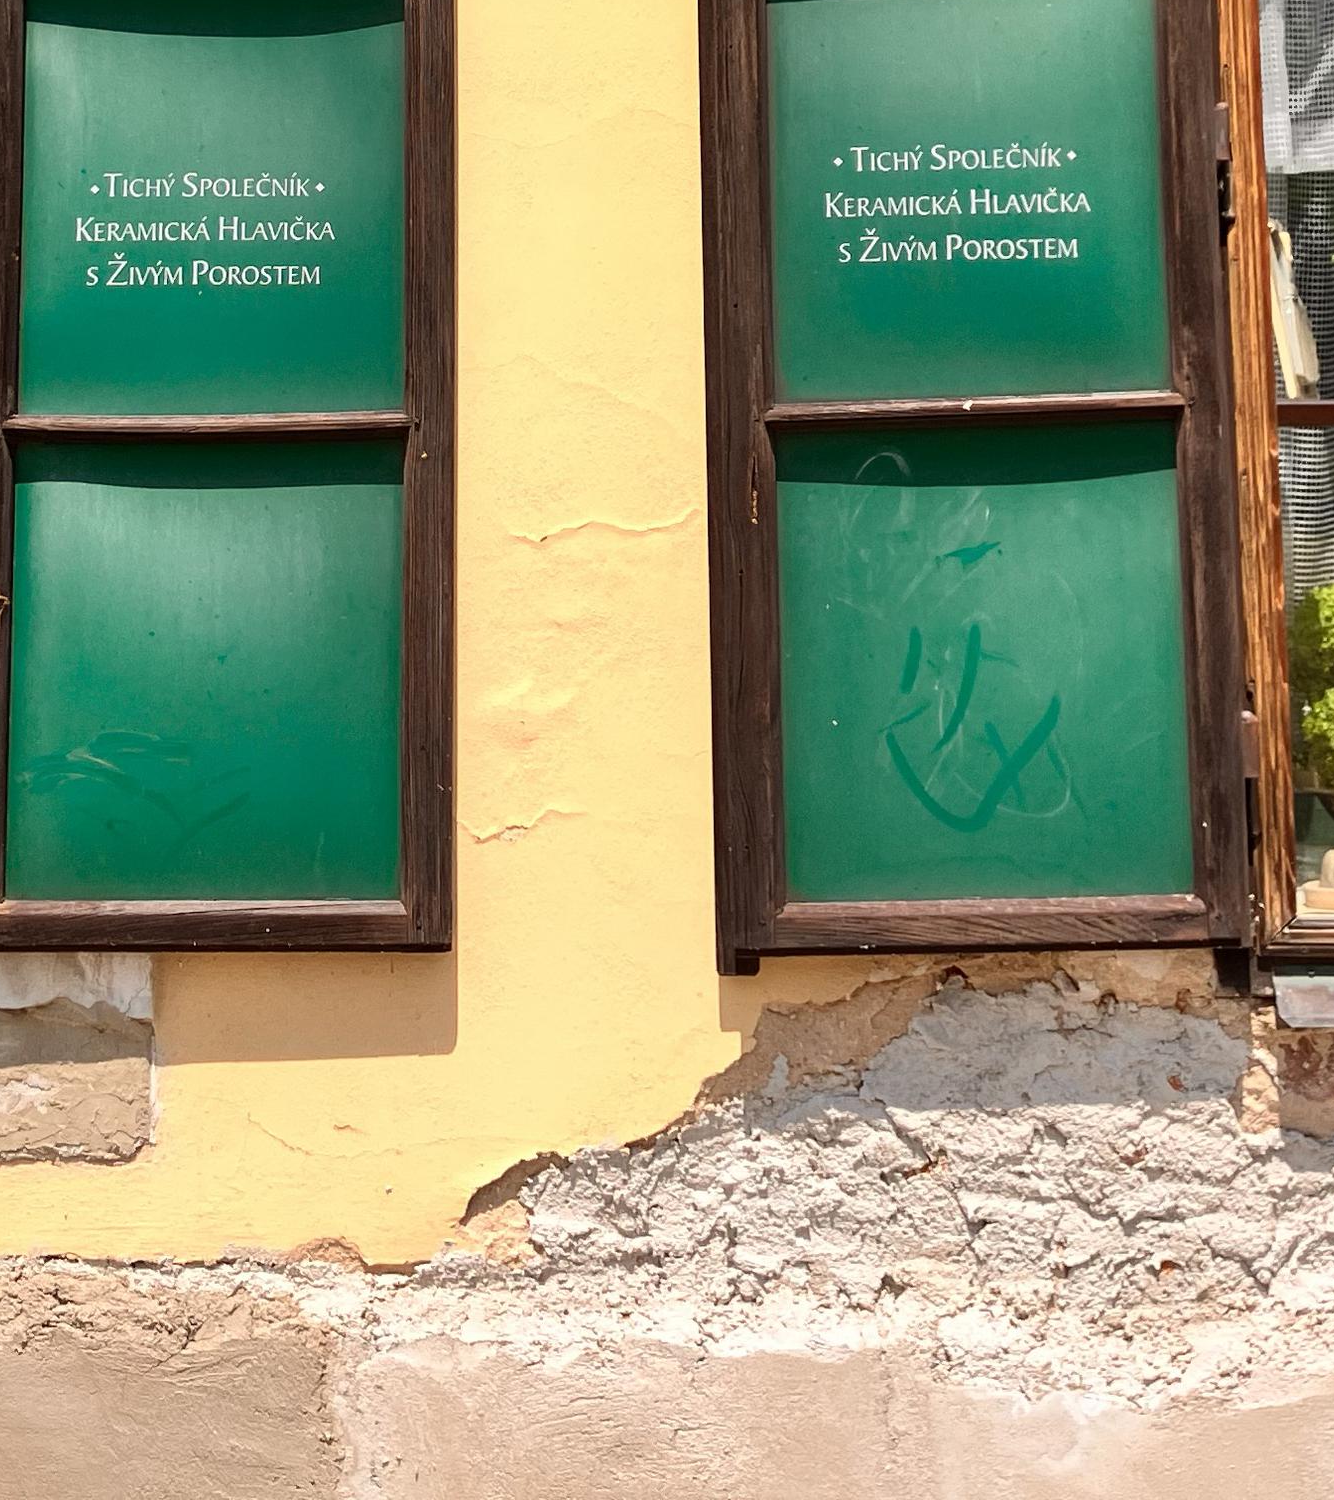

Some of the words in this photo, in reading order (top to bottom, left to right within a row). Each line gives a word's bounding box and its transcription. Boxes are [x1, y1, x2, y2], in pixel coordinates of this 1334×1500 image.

[850, 145, 923, 173] TICHÝ
[930, 142, 1062, 171] SPOLEČNÍK
[103, 172, 176, 198] TICHÝ
[181, 171, 310, 198] SPOLEČNÍK
[825, 189, 963, 218] KERAMICKÁ
[970, 187, 1092, 215] HLAVIČKA
[75, 216, 211, 242] KERAMICKÁ
[218, 216, 336, 242] HLAVIČKA
[859, 228, 938, 263] ŽIVÝM
[946, 234, 1079, 261] POROSTEM
[106, 252, 184, 287] ŽIVÝM
[192, 260, 322, 286] POROSTEM
